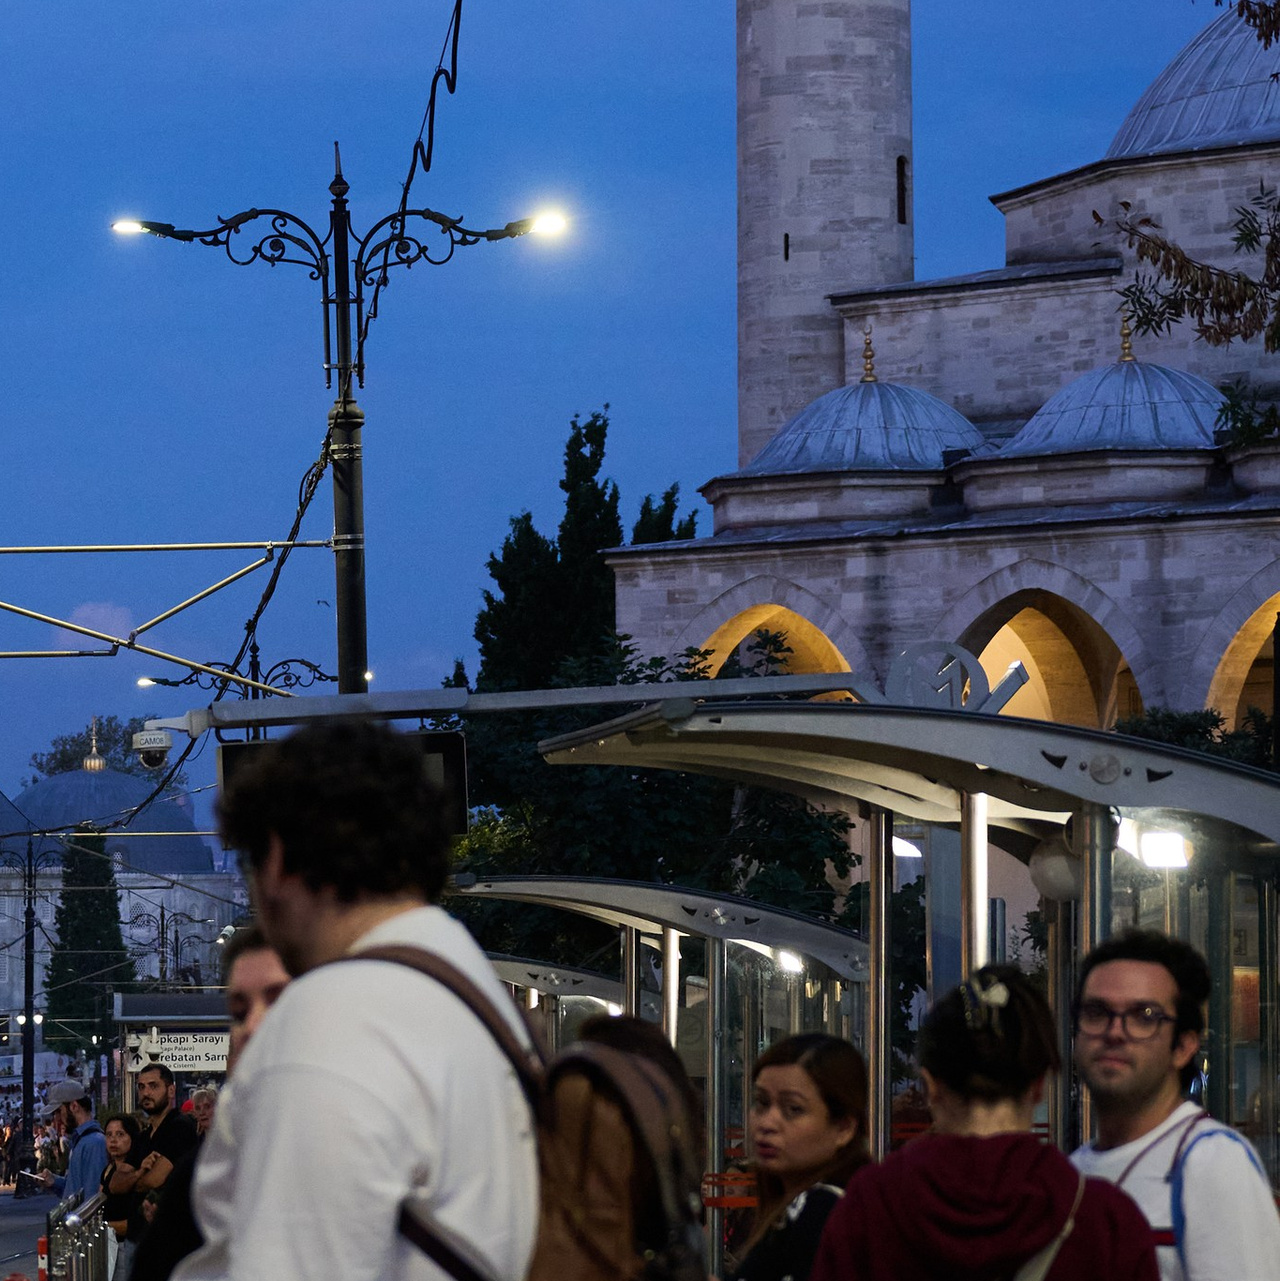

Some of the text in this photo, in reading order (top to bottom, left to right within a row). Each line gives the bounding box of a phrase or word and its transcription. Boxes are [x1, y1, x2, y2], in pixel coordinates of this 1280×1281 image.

[160, 1034, 224, 1045] pkapı Sarayı
[160, 1052, 201, 1062] rebatan
